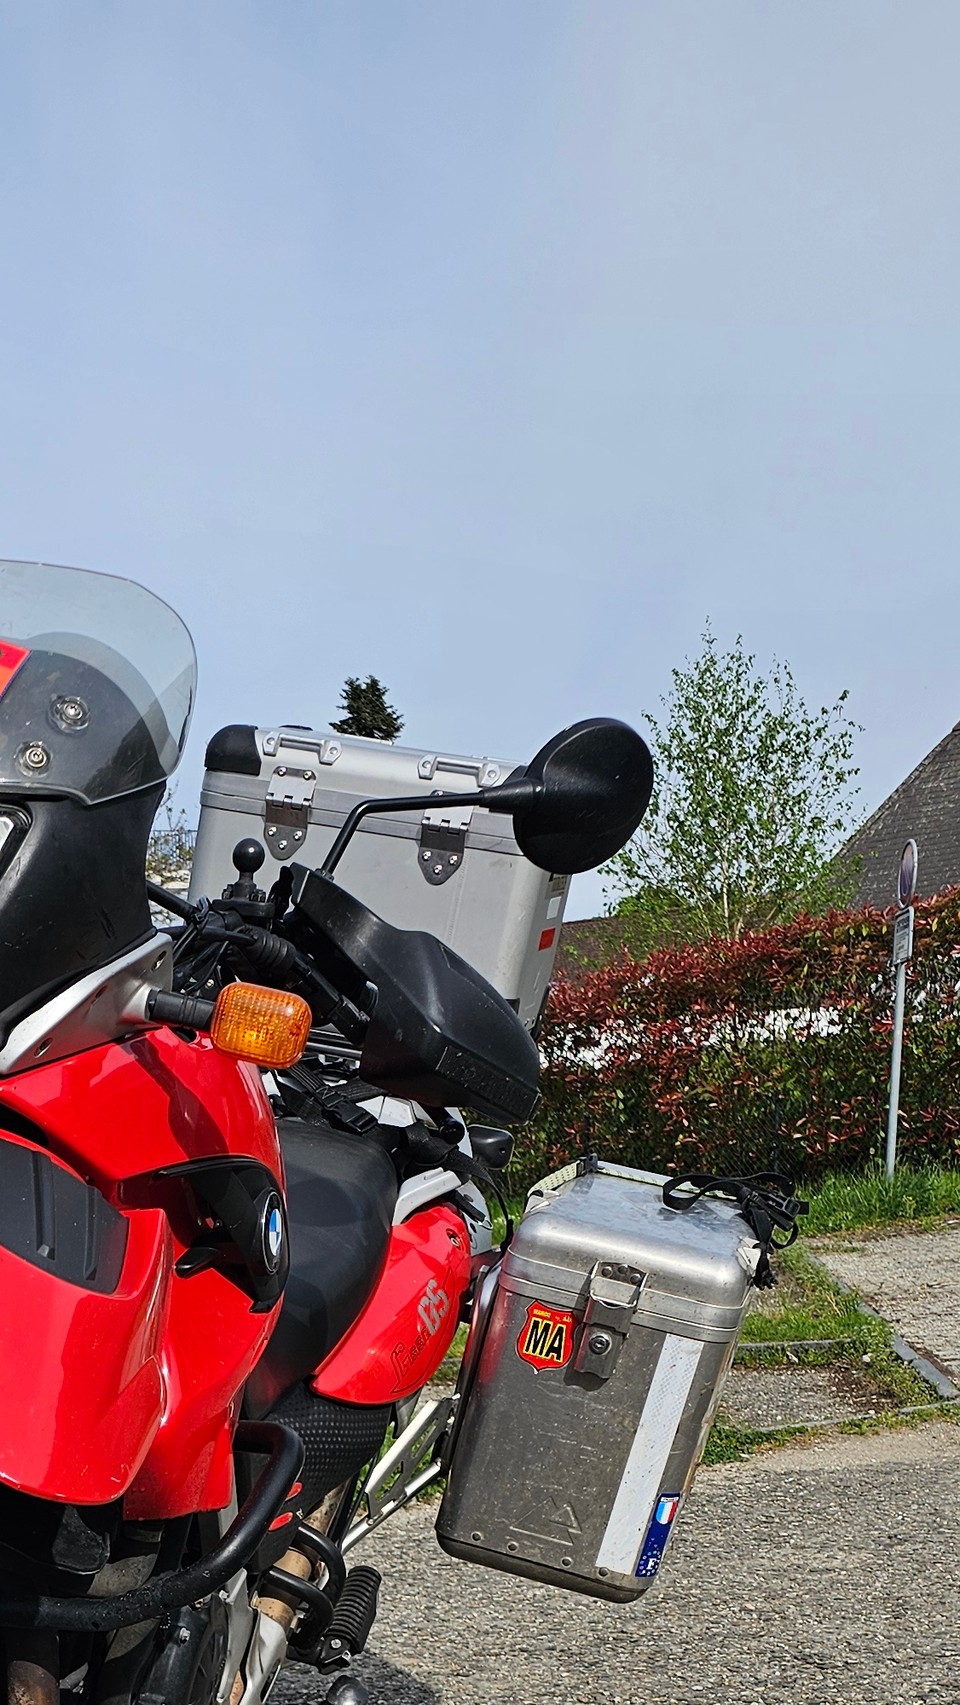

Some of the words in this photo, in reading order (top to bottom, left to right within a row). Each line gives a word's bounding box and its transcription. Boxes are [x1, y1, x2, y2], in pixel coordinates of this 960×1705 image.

[417, 1279, 450, 1336] GS
[523, 1318, 566, 1362] MA
[646, 1557, 657, 1570] F
